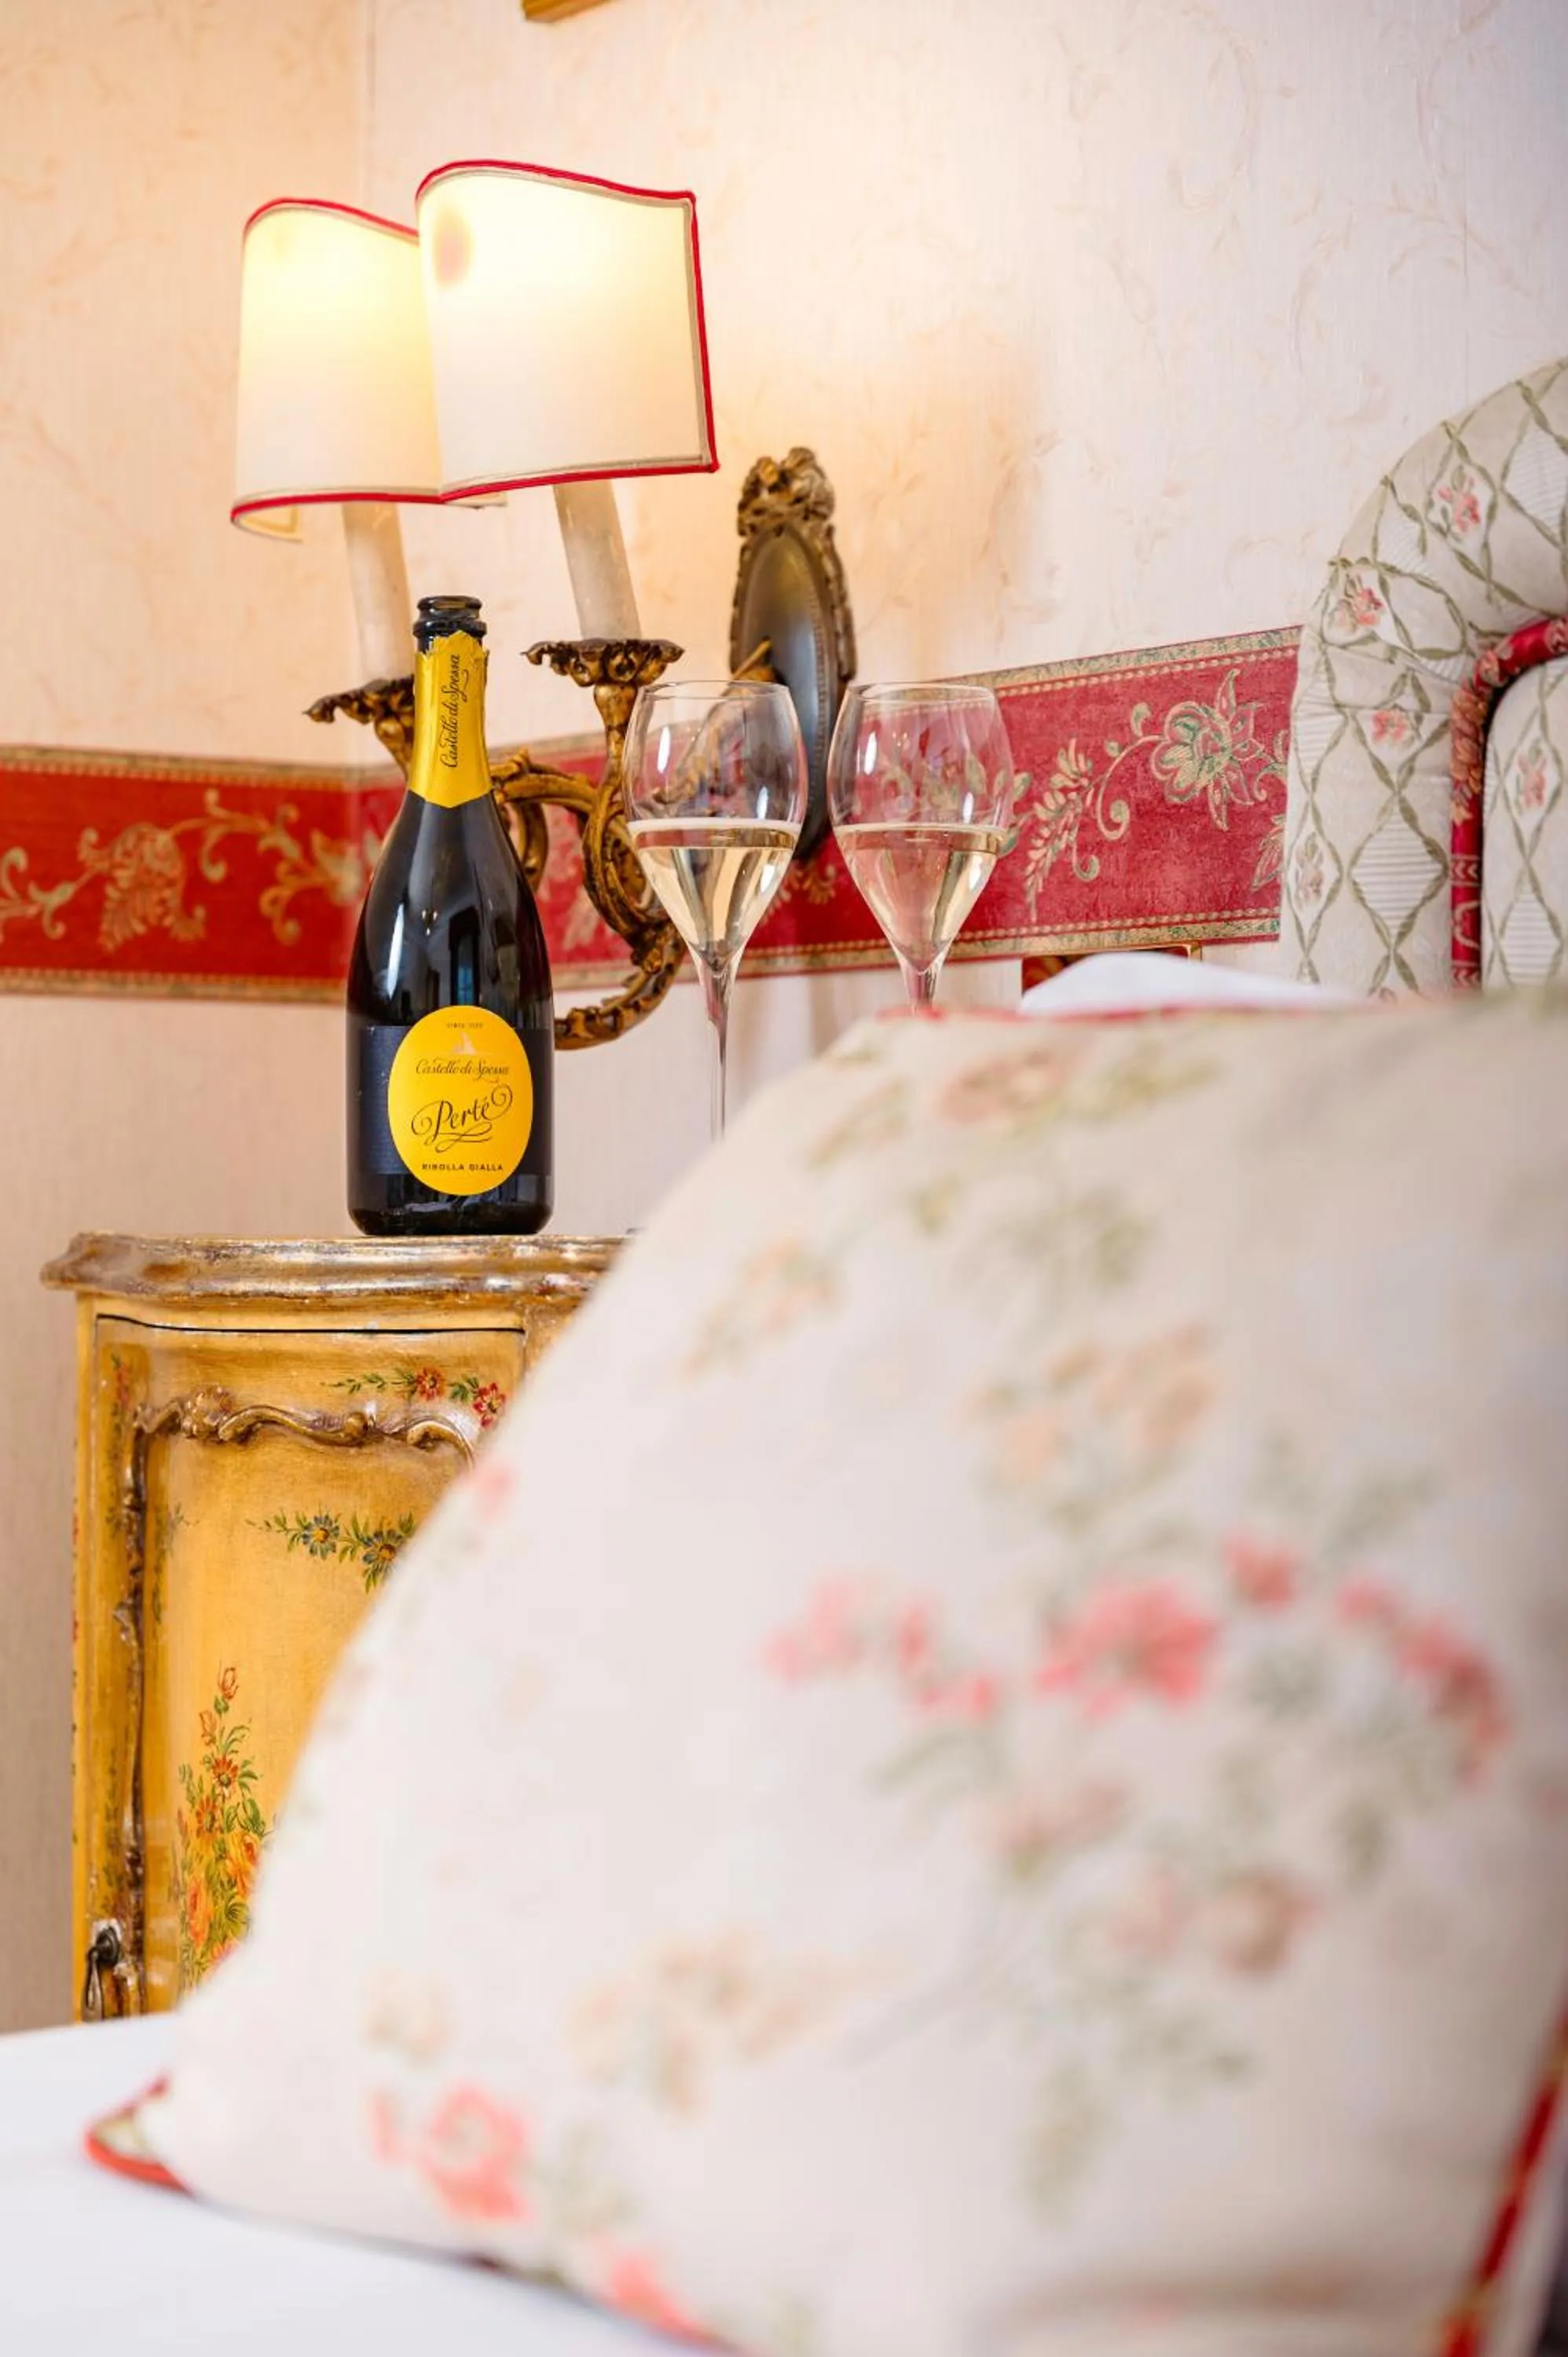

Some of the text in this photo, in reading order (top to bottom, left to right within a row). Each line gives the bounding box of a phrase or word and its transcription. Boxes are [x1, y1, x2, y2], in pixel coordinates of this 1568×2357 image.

[440, 654, 469, 768] Castello di Spessa
[416, 1058, 509, 1082] Castello di Spessa
[411, 1087, 512, 1149] Perté
